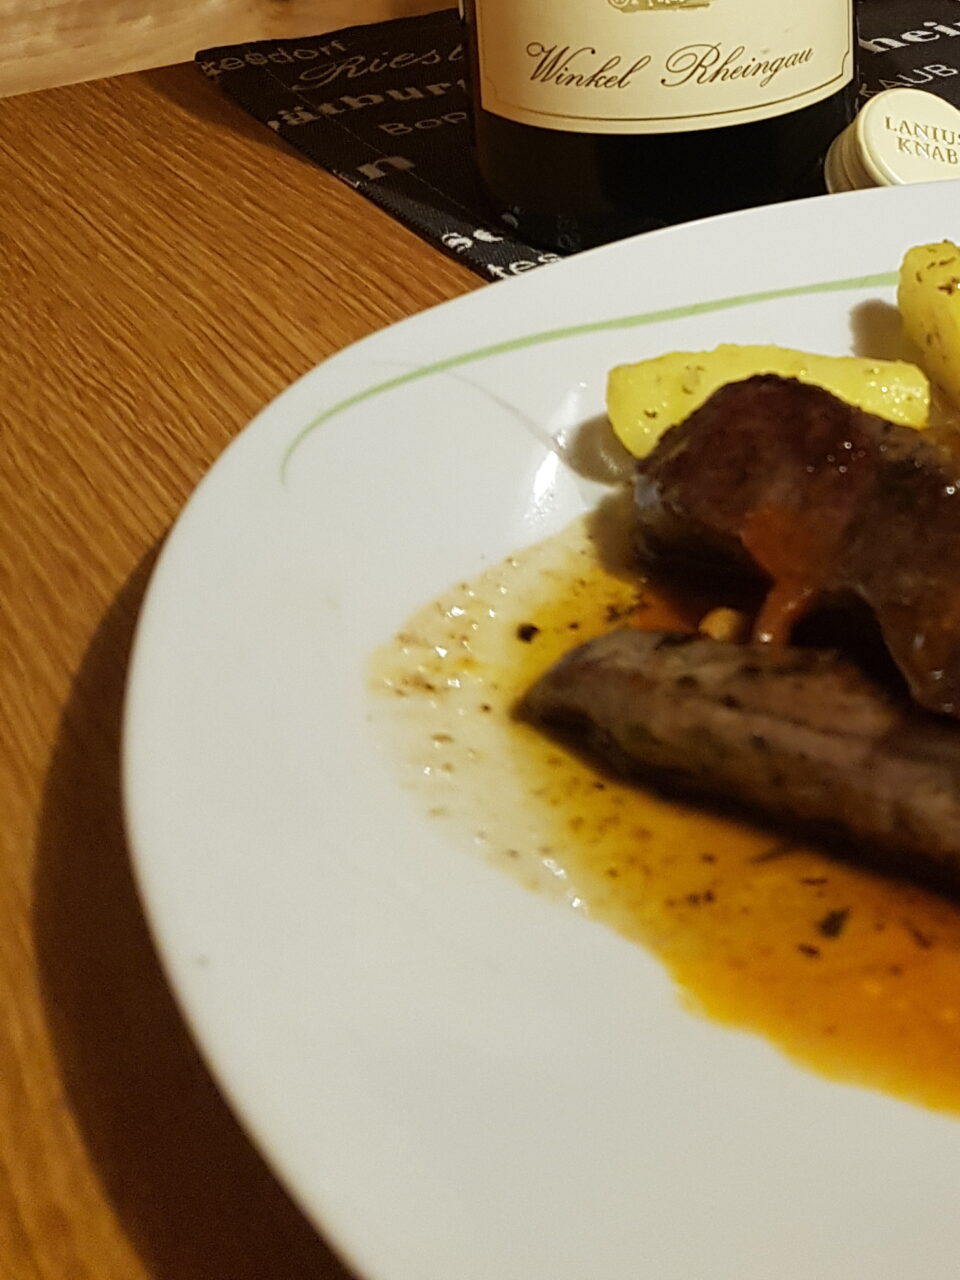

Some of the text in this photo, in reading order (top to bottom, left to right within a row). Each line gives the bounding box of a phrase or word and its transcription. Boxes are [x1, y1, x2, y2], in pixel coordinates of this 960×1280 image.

[526, 41, 814, 90] Winkel Rheingau
[896, 136, 959, 165] KNAB
